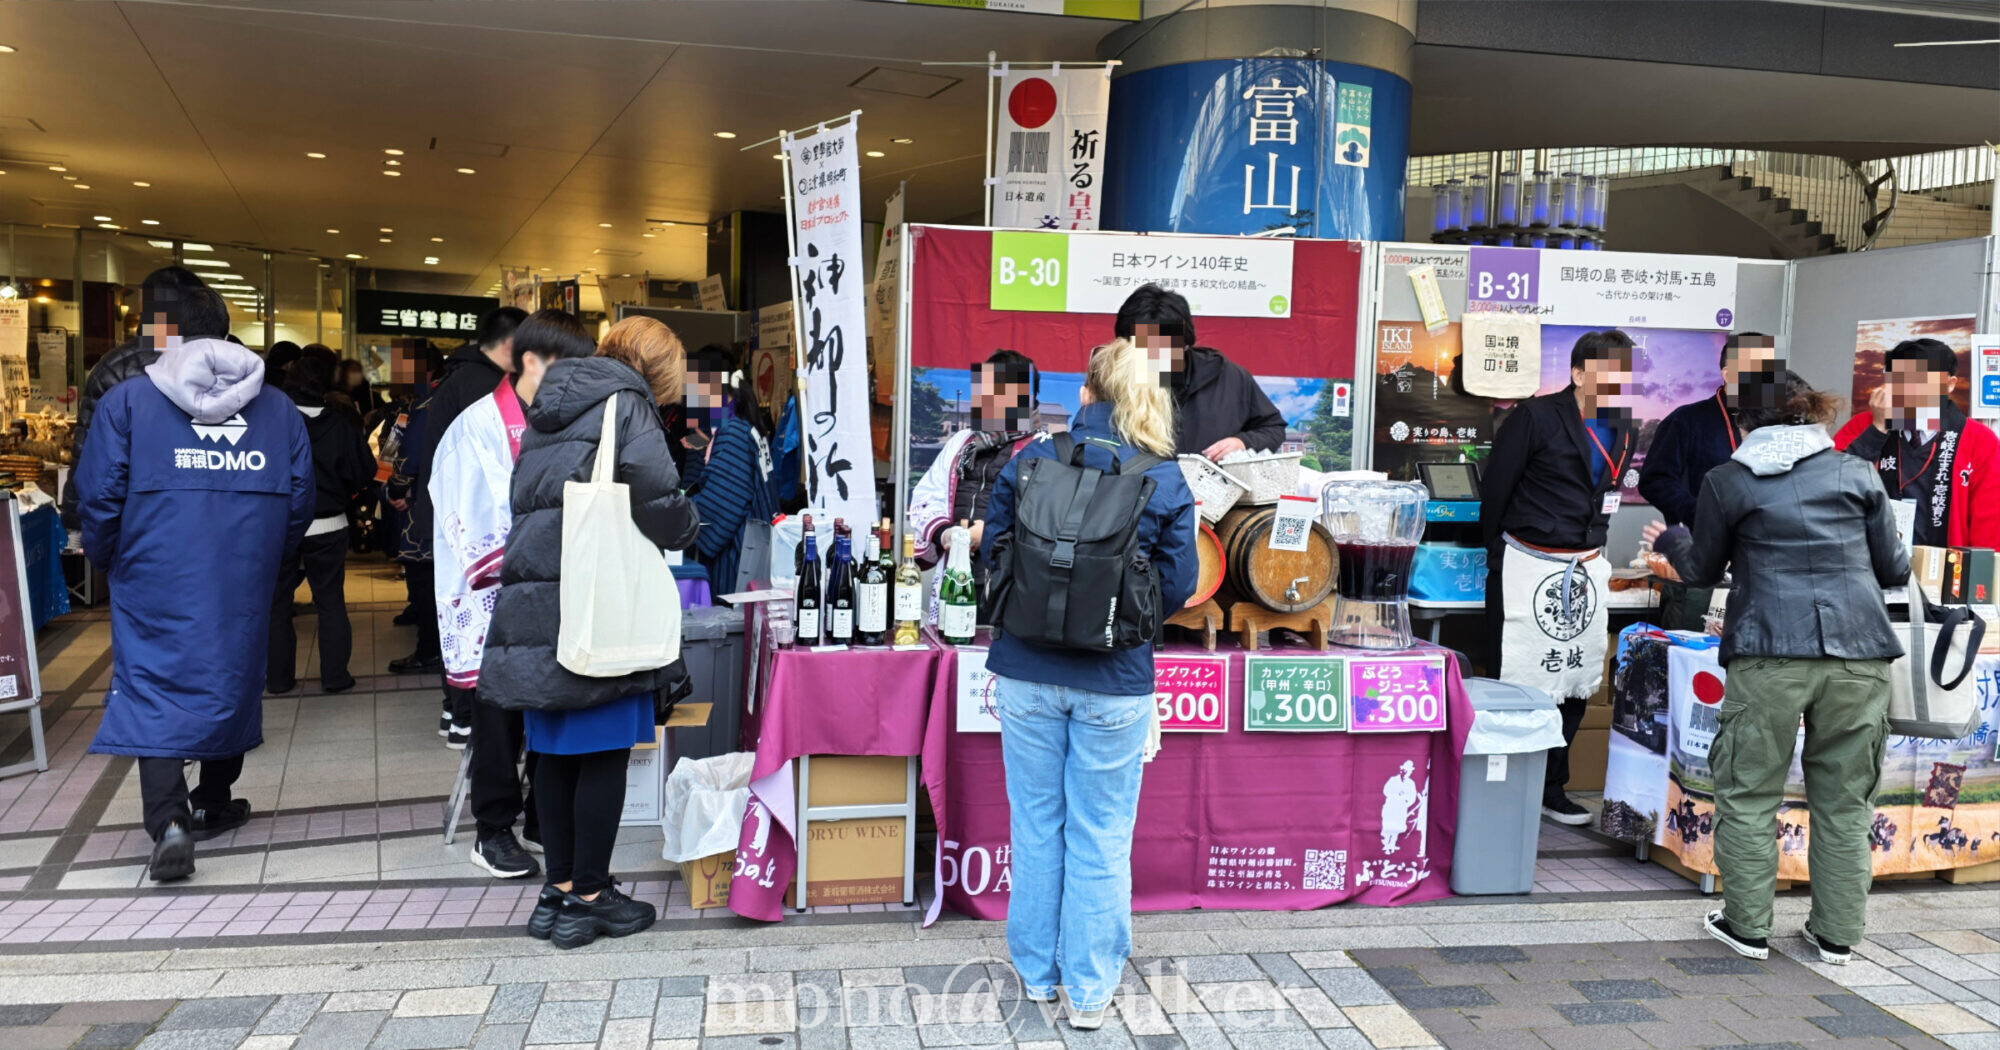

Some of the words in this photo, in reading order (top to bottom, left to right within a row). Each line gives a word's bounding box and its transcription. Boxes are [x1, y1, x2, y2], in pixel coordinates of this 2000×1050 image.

[1005, 191, 1047, 202] 日本遺産
[1112, 253, 1248, 272] 日本ワイン140年史
[1000, 257, 1060, 287] B-30
[1561, 266, 1617, 283] 国境の島
[1620, 268, 1717, 287] 壱岐・対馬・五島
[1478, 271, 1529, 300] B-31
[381, 309, 477, 331] 三省堂書店
[1628, 315, 1647, 324] 長崎県
[1382, 328, 1413, 343] IKI
[1382, 341, 1413, 350] ISLAND
[1413, 427, 1477, 438] 実りの島、壱岐
[1771, 430, 1804, 441] THE
[1750, 441, 1804, 456] NORTH
[1880, 456, 1896, 471] 岐
[1540, 646, 1583, 672] 壱岐
[1261, 666, 1333, 679] カップワイン
[1362, 666, 1403, 680] ぶどう
[1260, 679, 1333, 691] (甲州・辛口)
[1378, 680, 1430, 693] ジュース
[856, 825, 899, 838] WINE
